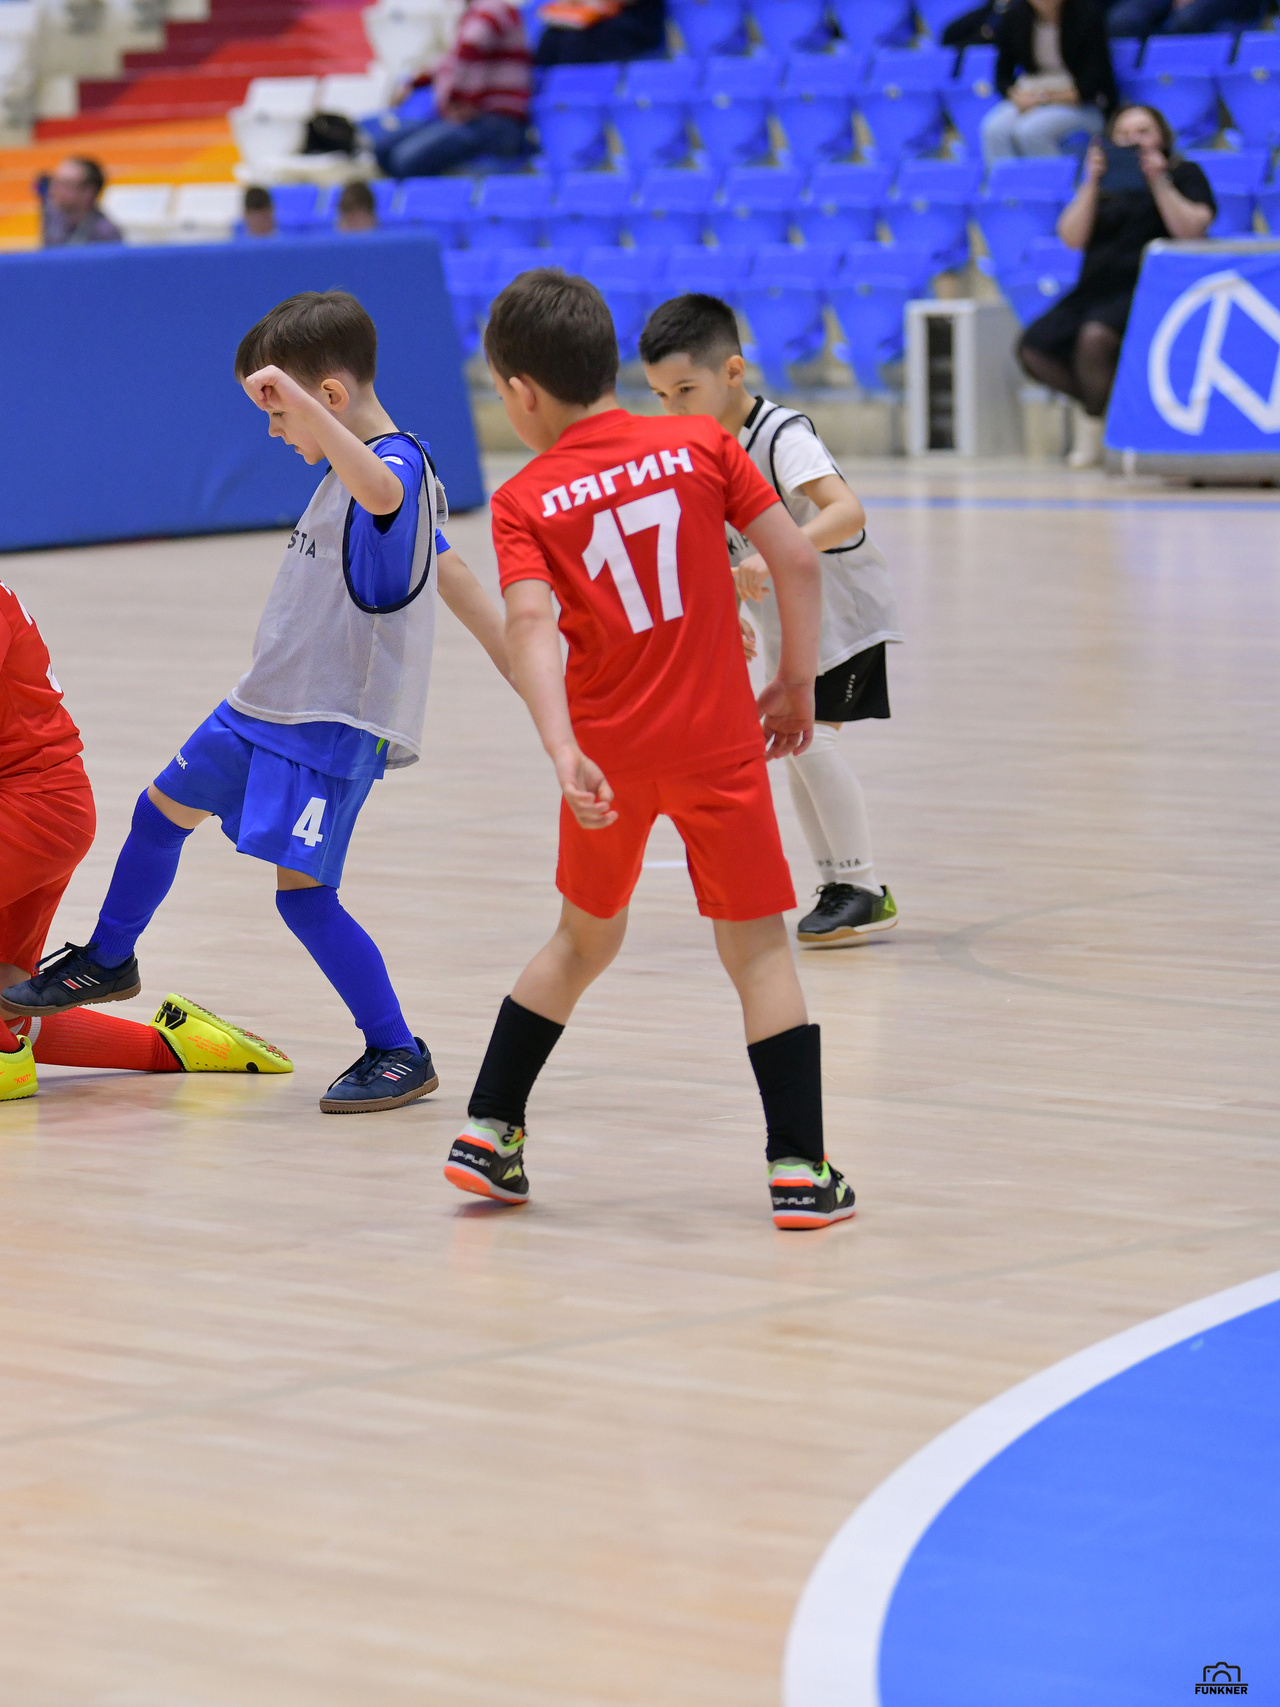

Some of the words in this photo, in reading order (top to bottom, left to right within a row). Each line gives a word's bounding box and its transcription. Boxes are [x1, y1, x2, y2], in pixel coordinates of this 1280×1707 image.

[541, 447, 694, 518] ЛЯГИН
[581, 488, 684, 634] 17
[292, 796, 327, 847] 4
